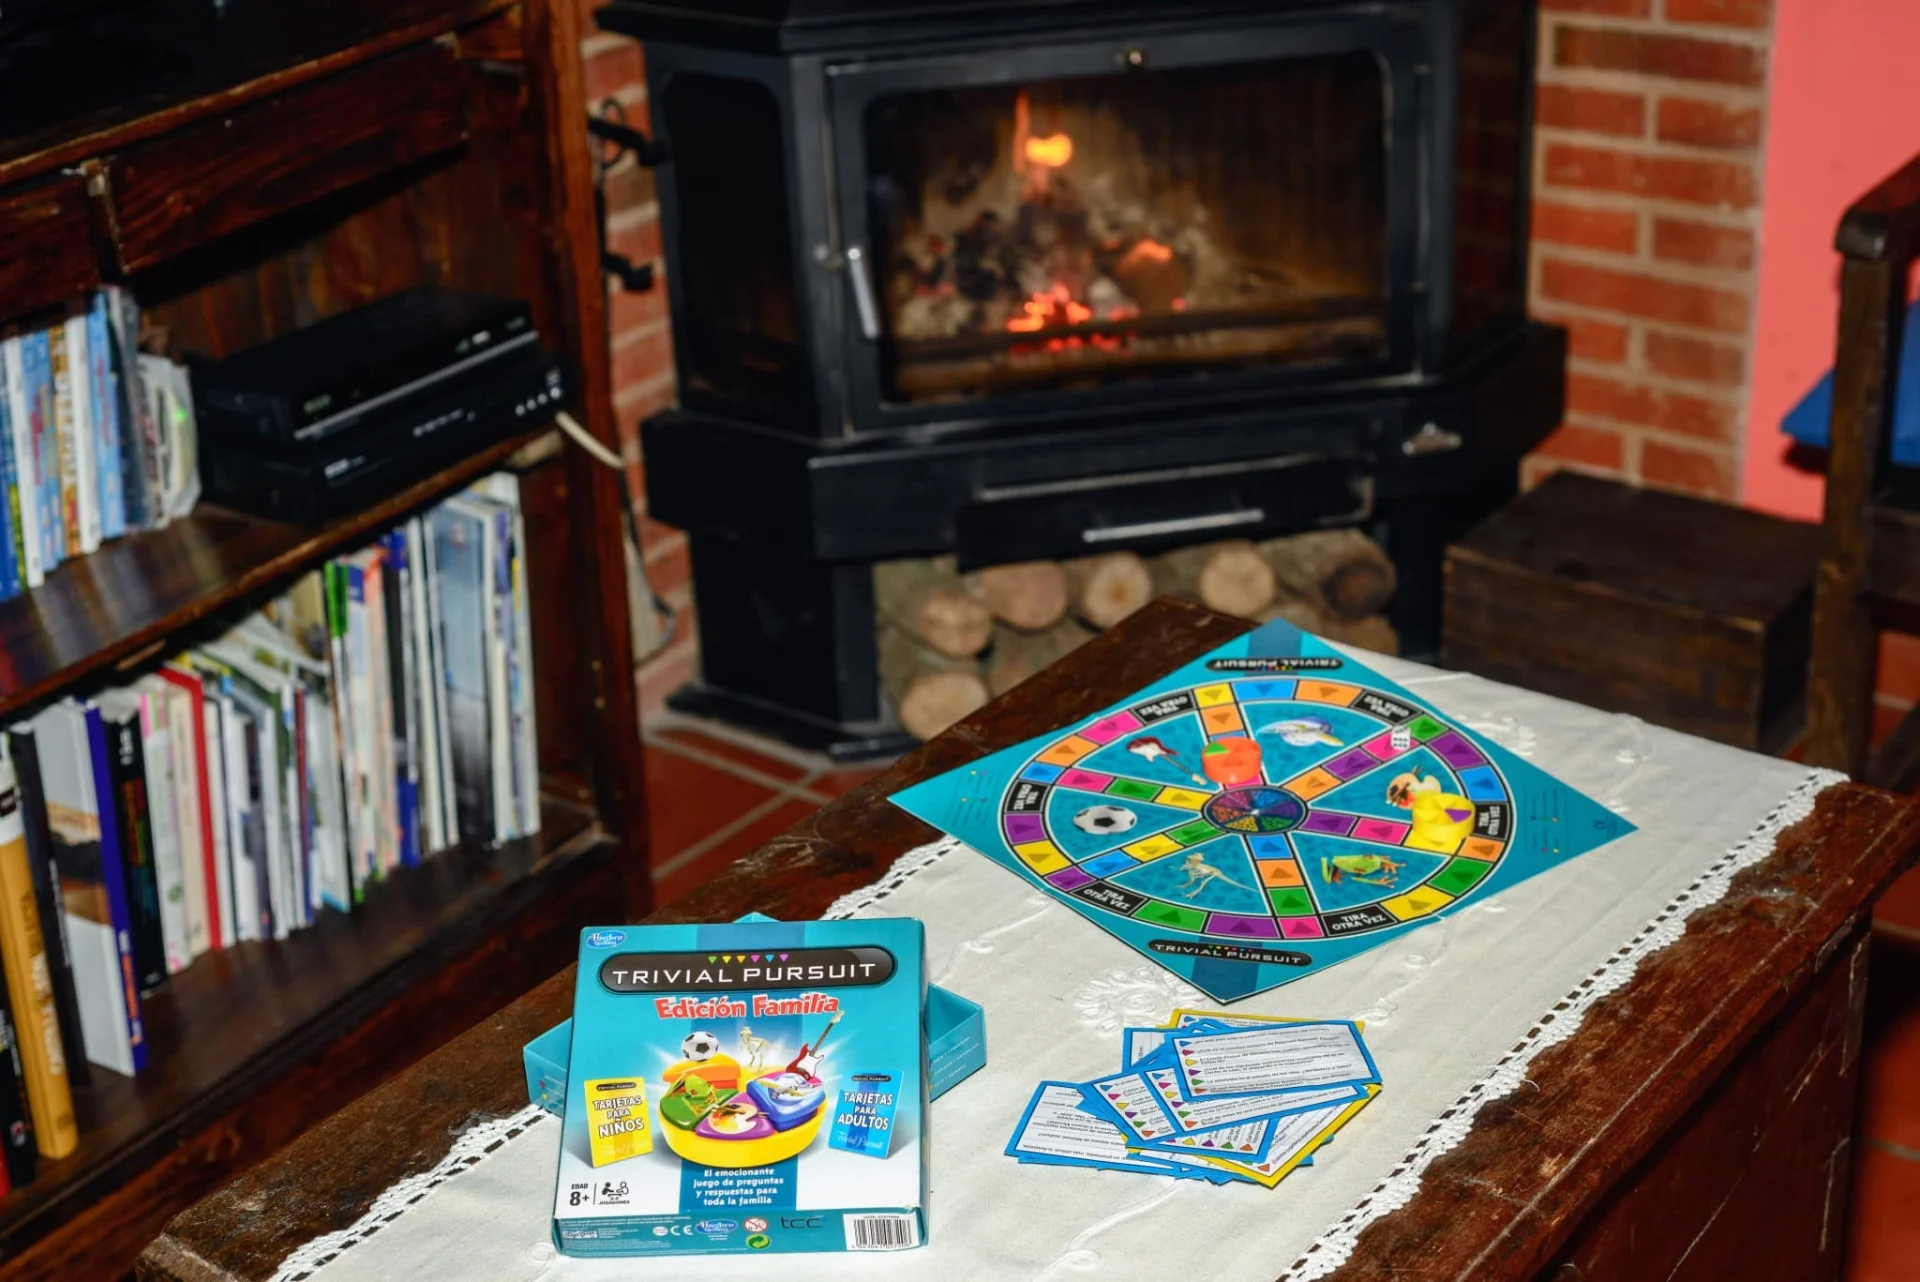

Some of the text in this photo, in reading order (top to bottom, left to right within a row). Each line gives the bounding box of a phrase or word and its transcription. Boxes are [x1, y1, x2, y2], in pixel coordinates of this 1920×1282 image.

[1332, 914, 1387, 931] OTRA VEZ
[1341, 912, 1368, 923] TIRA
[1154, 943, 1302, 965] TRIVIAL PURSUIT
[612, 963, 876, 985] TRIVIAL PURSUIT
[654, 992, 840, 1020] Edición Familia
[592, 1095, 642, 1111] TARJETAS
[843, 1092, 893, 1106] TARJETAS
[607, 1108, 631, 1120] PARA
[854, 1105, 877, 1115] PARA
[598, 1118, 645, 1138] NIÑOS
[837, 1113, 889, 1131] ADULTOS
[704, 1168, 775, 1177] El emocionante
[693, 1177, 784, 1188] juego de preguntas
[569, 1191, 590, 1207] 8+
[696, 1187, 778, 1198] y respuestas para
[703, 1196, 772, 1206] toda la familia
[780, 1216, 823, 1229] tcc
